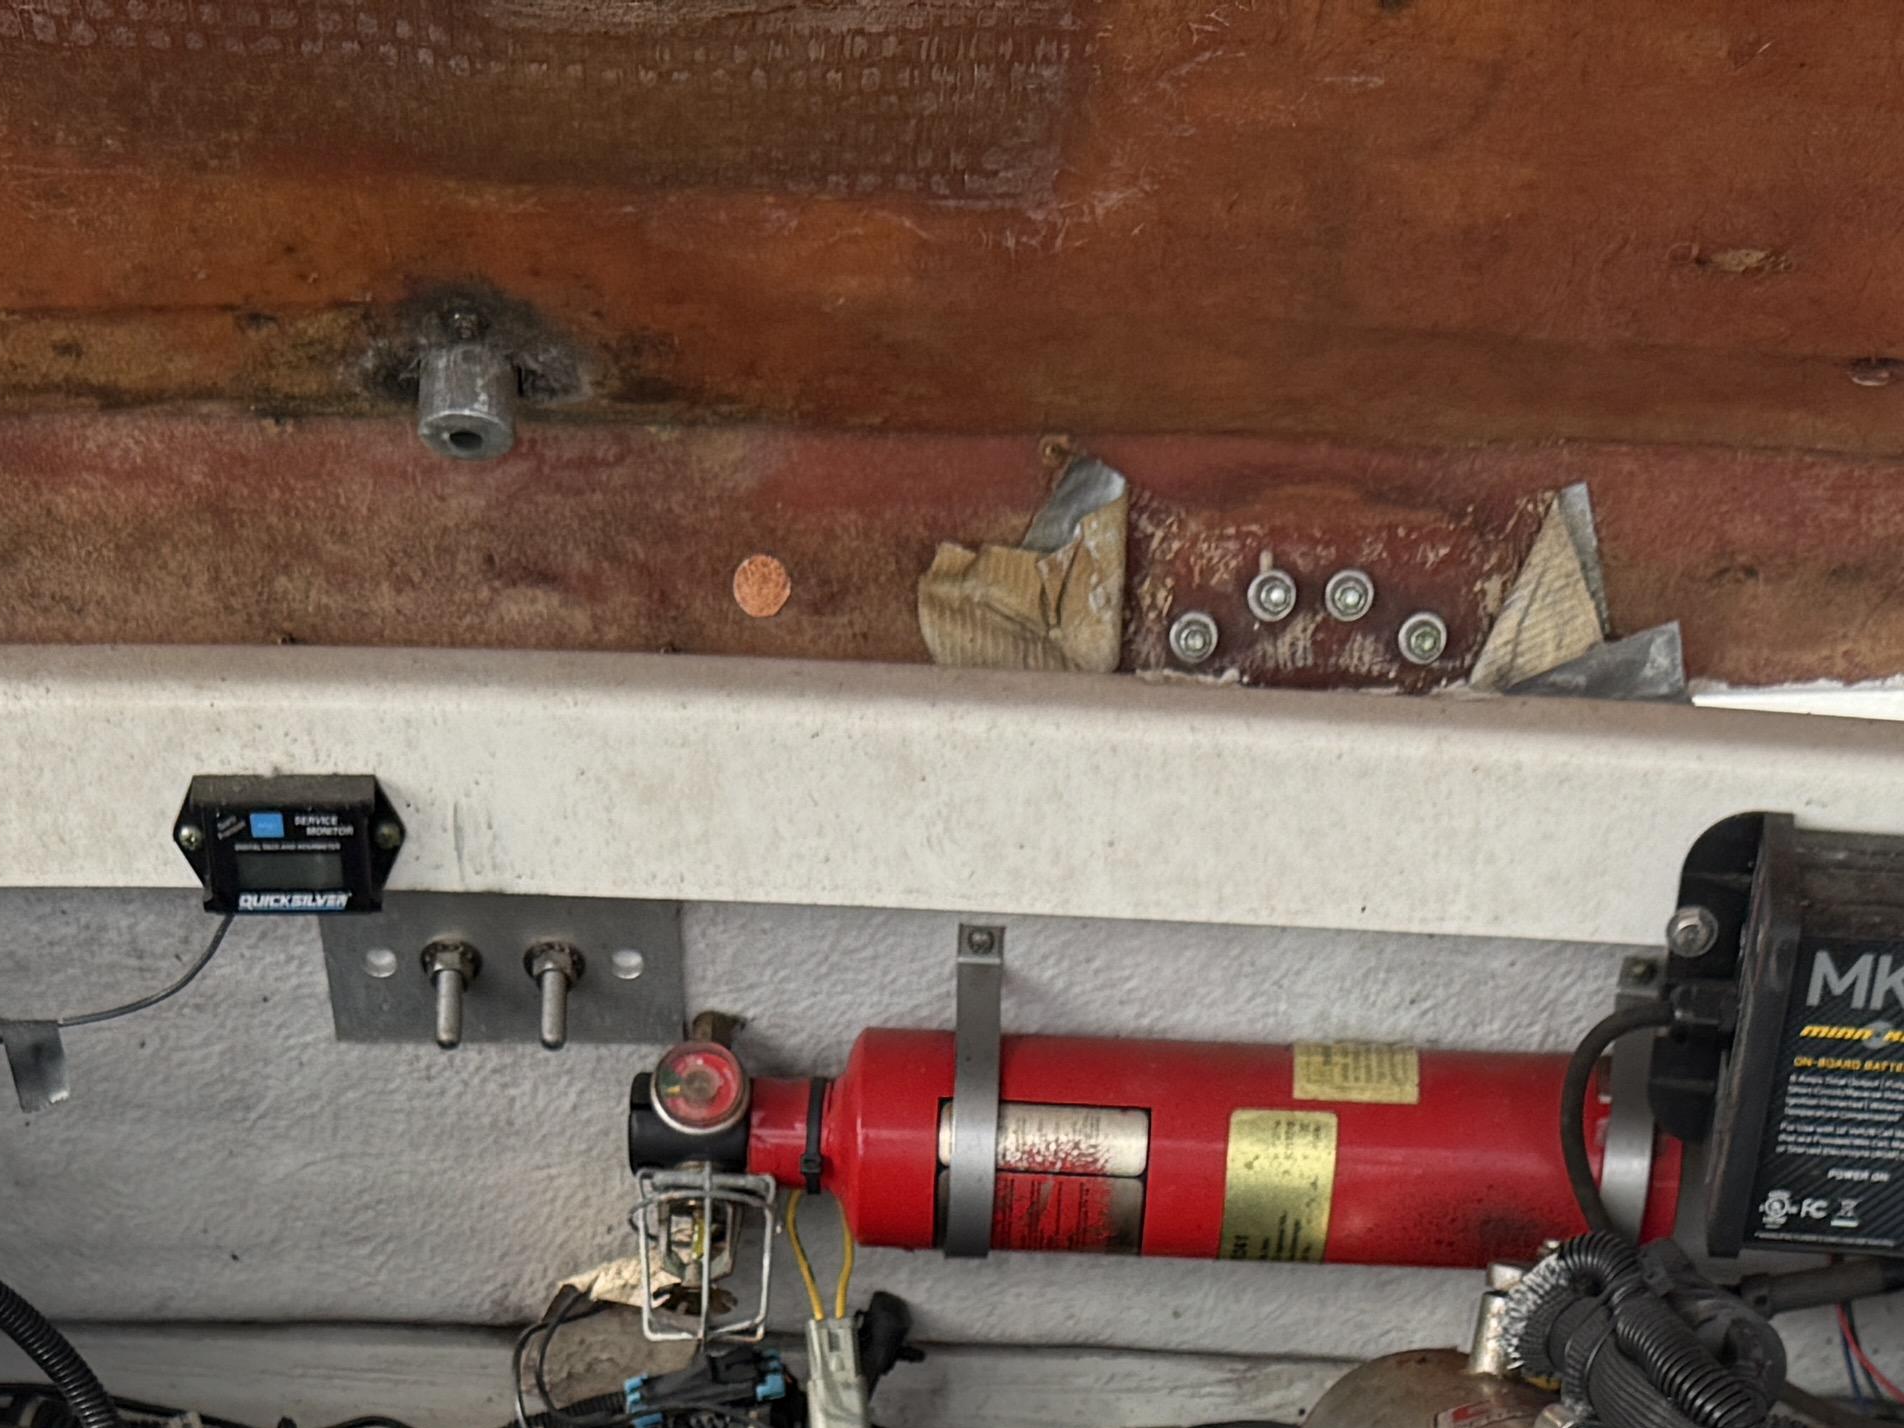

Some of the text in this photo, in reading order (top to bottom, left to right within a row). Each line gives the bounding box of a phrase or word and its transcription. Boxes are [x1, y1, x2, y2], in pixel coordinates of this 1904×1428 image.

[295, 816, 338, 826] SERVICE
[306, 827, 354, 837] MONITOR
[238, 891, 349, 910] QUICKSILVER
[1793, 1056, 1861, 1071] ON-BOARD
[1827, 1168, 1890, 1182] POWER ON
